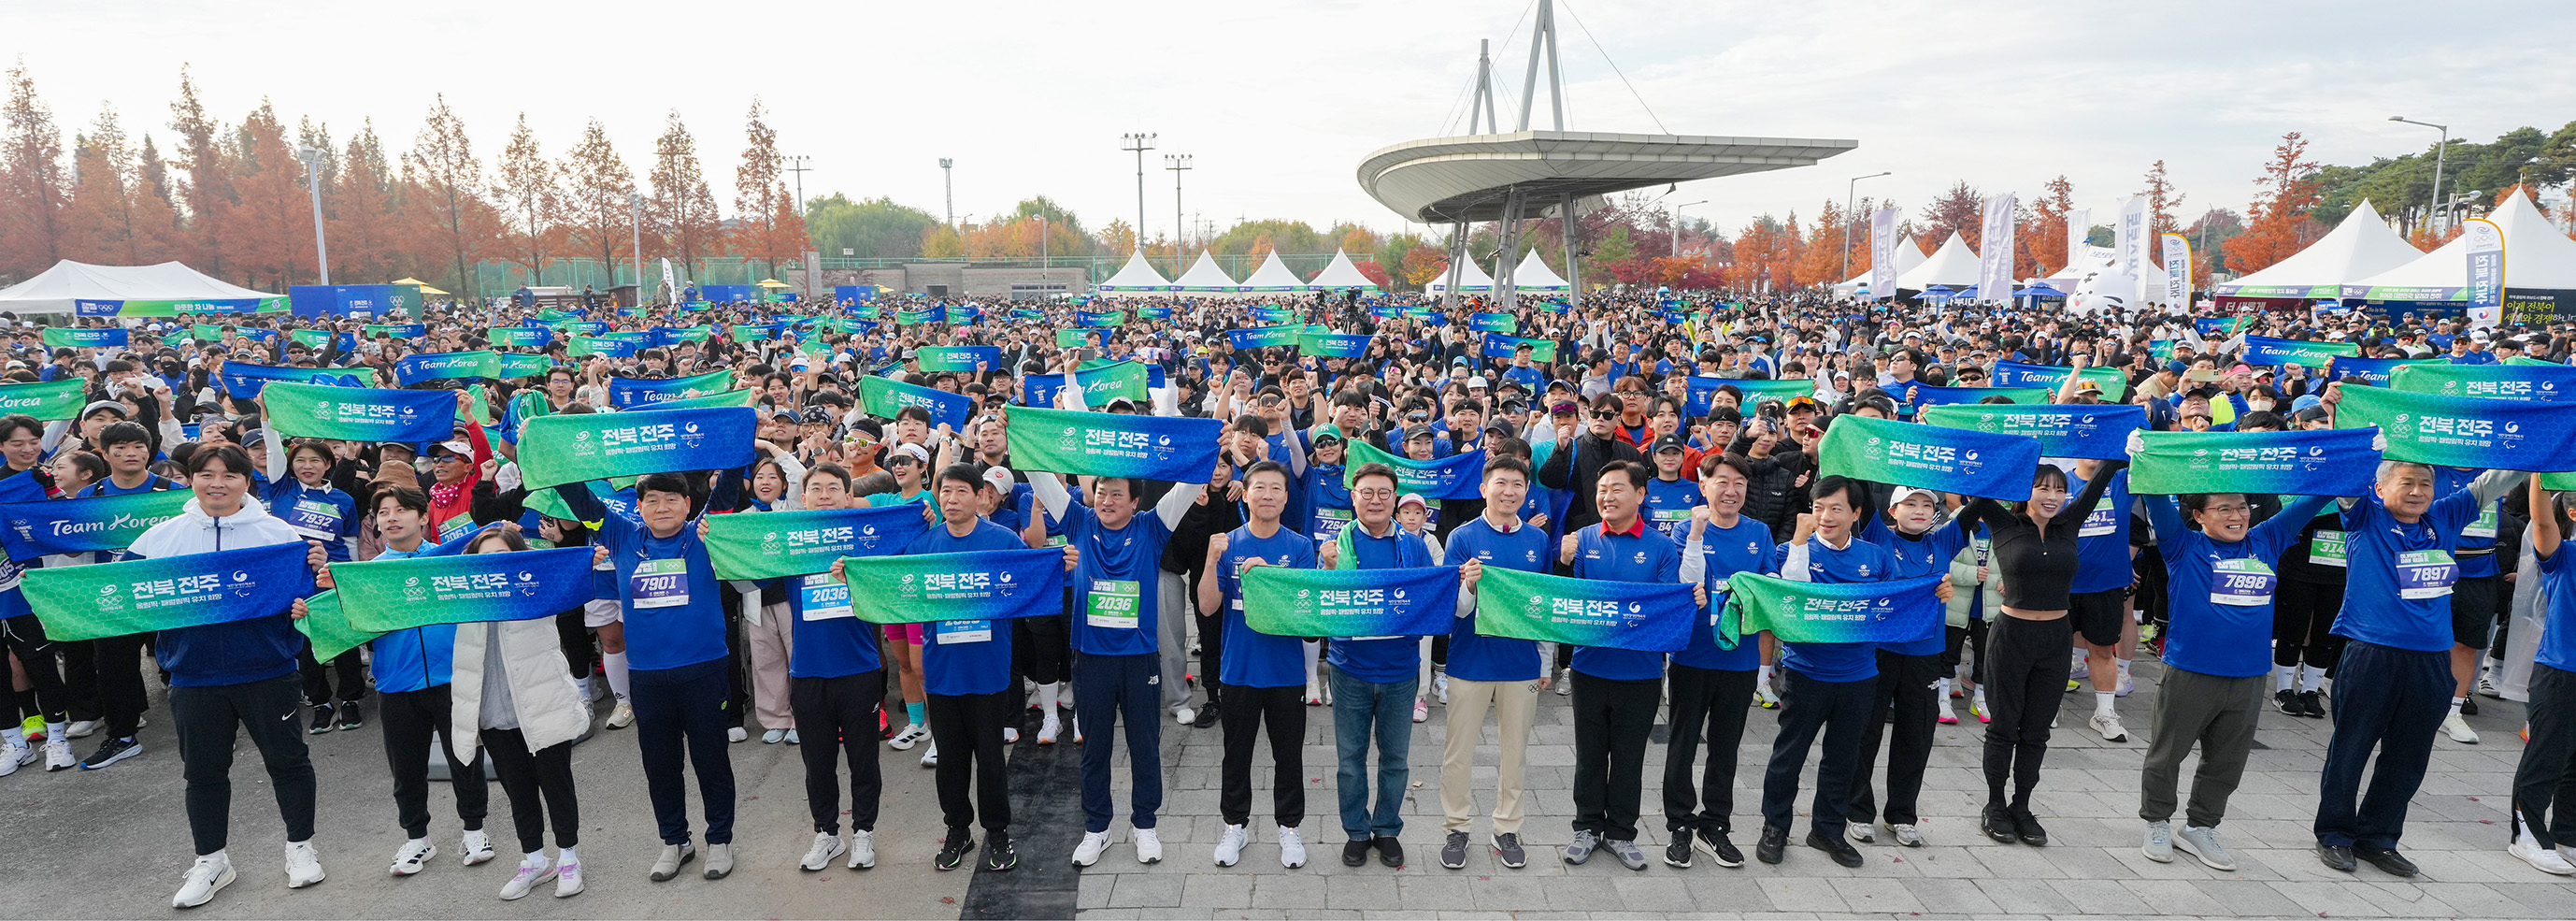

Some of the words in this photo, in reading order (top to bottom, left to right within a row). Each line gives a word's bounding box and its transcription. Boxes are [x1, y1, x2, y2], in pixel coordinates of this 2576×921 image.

[1491, 318, 1508, 326] Korea
[1246, 332, 1265, 340] Team
[1265, 330, 1286, 339] Korea
[2260, 345, 2289, 356] Team
[2290, 347, 2328, 359] Korea
[419, 361, 447, 369] Team
[447, 357, 479, 368] Korea
[508, 360, 537, 371] Korea
[2021, 370, 2054, 383] Team
[2358, 369, 2389, 381] Team
[1087, 378, 1123, 394] Korea
[2466, 381, 2497, 395] 전북
[2499, 381, 2532, 395] 전주
[898, 391, 916, 406] 전북
[916, 396, 934, 409] 전주
[1745, 391, 1783, 403] Korea
[337, 402, 366, 416] 전북
[367, 404, 395, 418] 전주
[2003, 413, 2037, 428] 전북
[2038, 413, 2072, 428] 전주
[2419, 415, 2454, 435] 전북
[2456, 417, 2493, 438] 전주
[601, 426, 638, 446] 전북
[639, 424, 676, 442] 전주
[1084, 428, 1118, 447] 전북
[1118, 430, 1150, 450] 전주
[1888, 439, 1921, 459] 전북
[1923, 442, 1955, 464] 전주
[2219, 447, 2257, 462] 전북
[2258, 446, 2297, 461] 전주
[299, 511, 334, 527] 7932
[50, 519, 104, 537] Team
[786, 529, 820, 547] 전북
[821, 526, 854, 544] 전주
[430, 574, 470, 592] 전북
[470, 572, 508, 590] 전주
[923, 572, 957, 591] 전북
[957, 572, 991, 590] 전주
[2224, 573, 2268, 590] 7898
[2411, 566, 2450, 582] 7897
[131, 579, 176, 600] 전북
[178, 573, 221, 596] 전주
[639, 575, 677, 592] 7901
[811, 586, 848, 603] 2036
[1319, 589, 1352, 606] 전북
[1352, 589, 1384, 606] 전주
[1095, 597, 1133, 612] 2036
[1552, 597, 1584, 616] 전북
[1586, 599, 1619, 618] 전주
[1804, 597, 1839, 612] 전북
[1839, 598, 1870, 612] 전주
